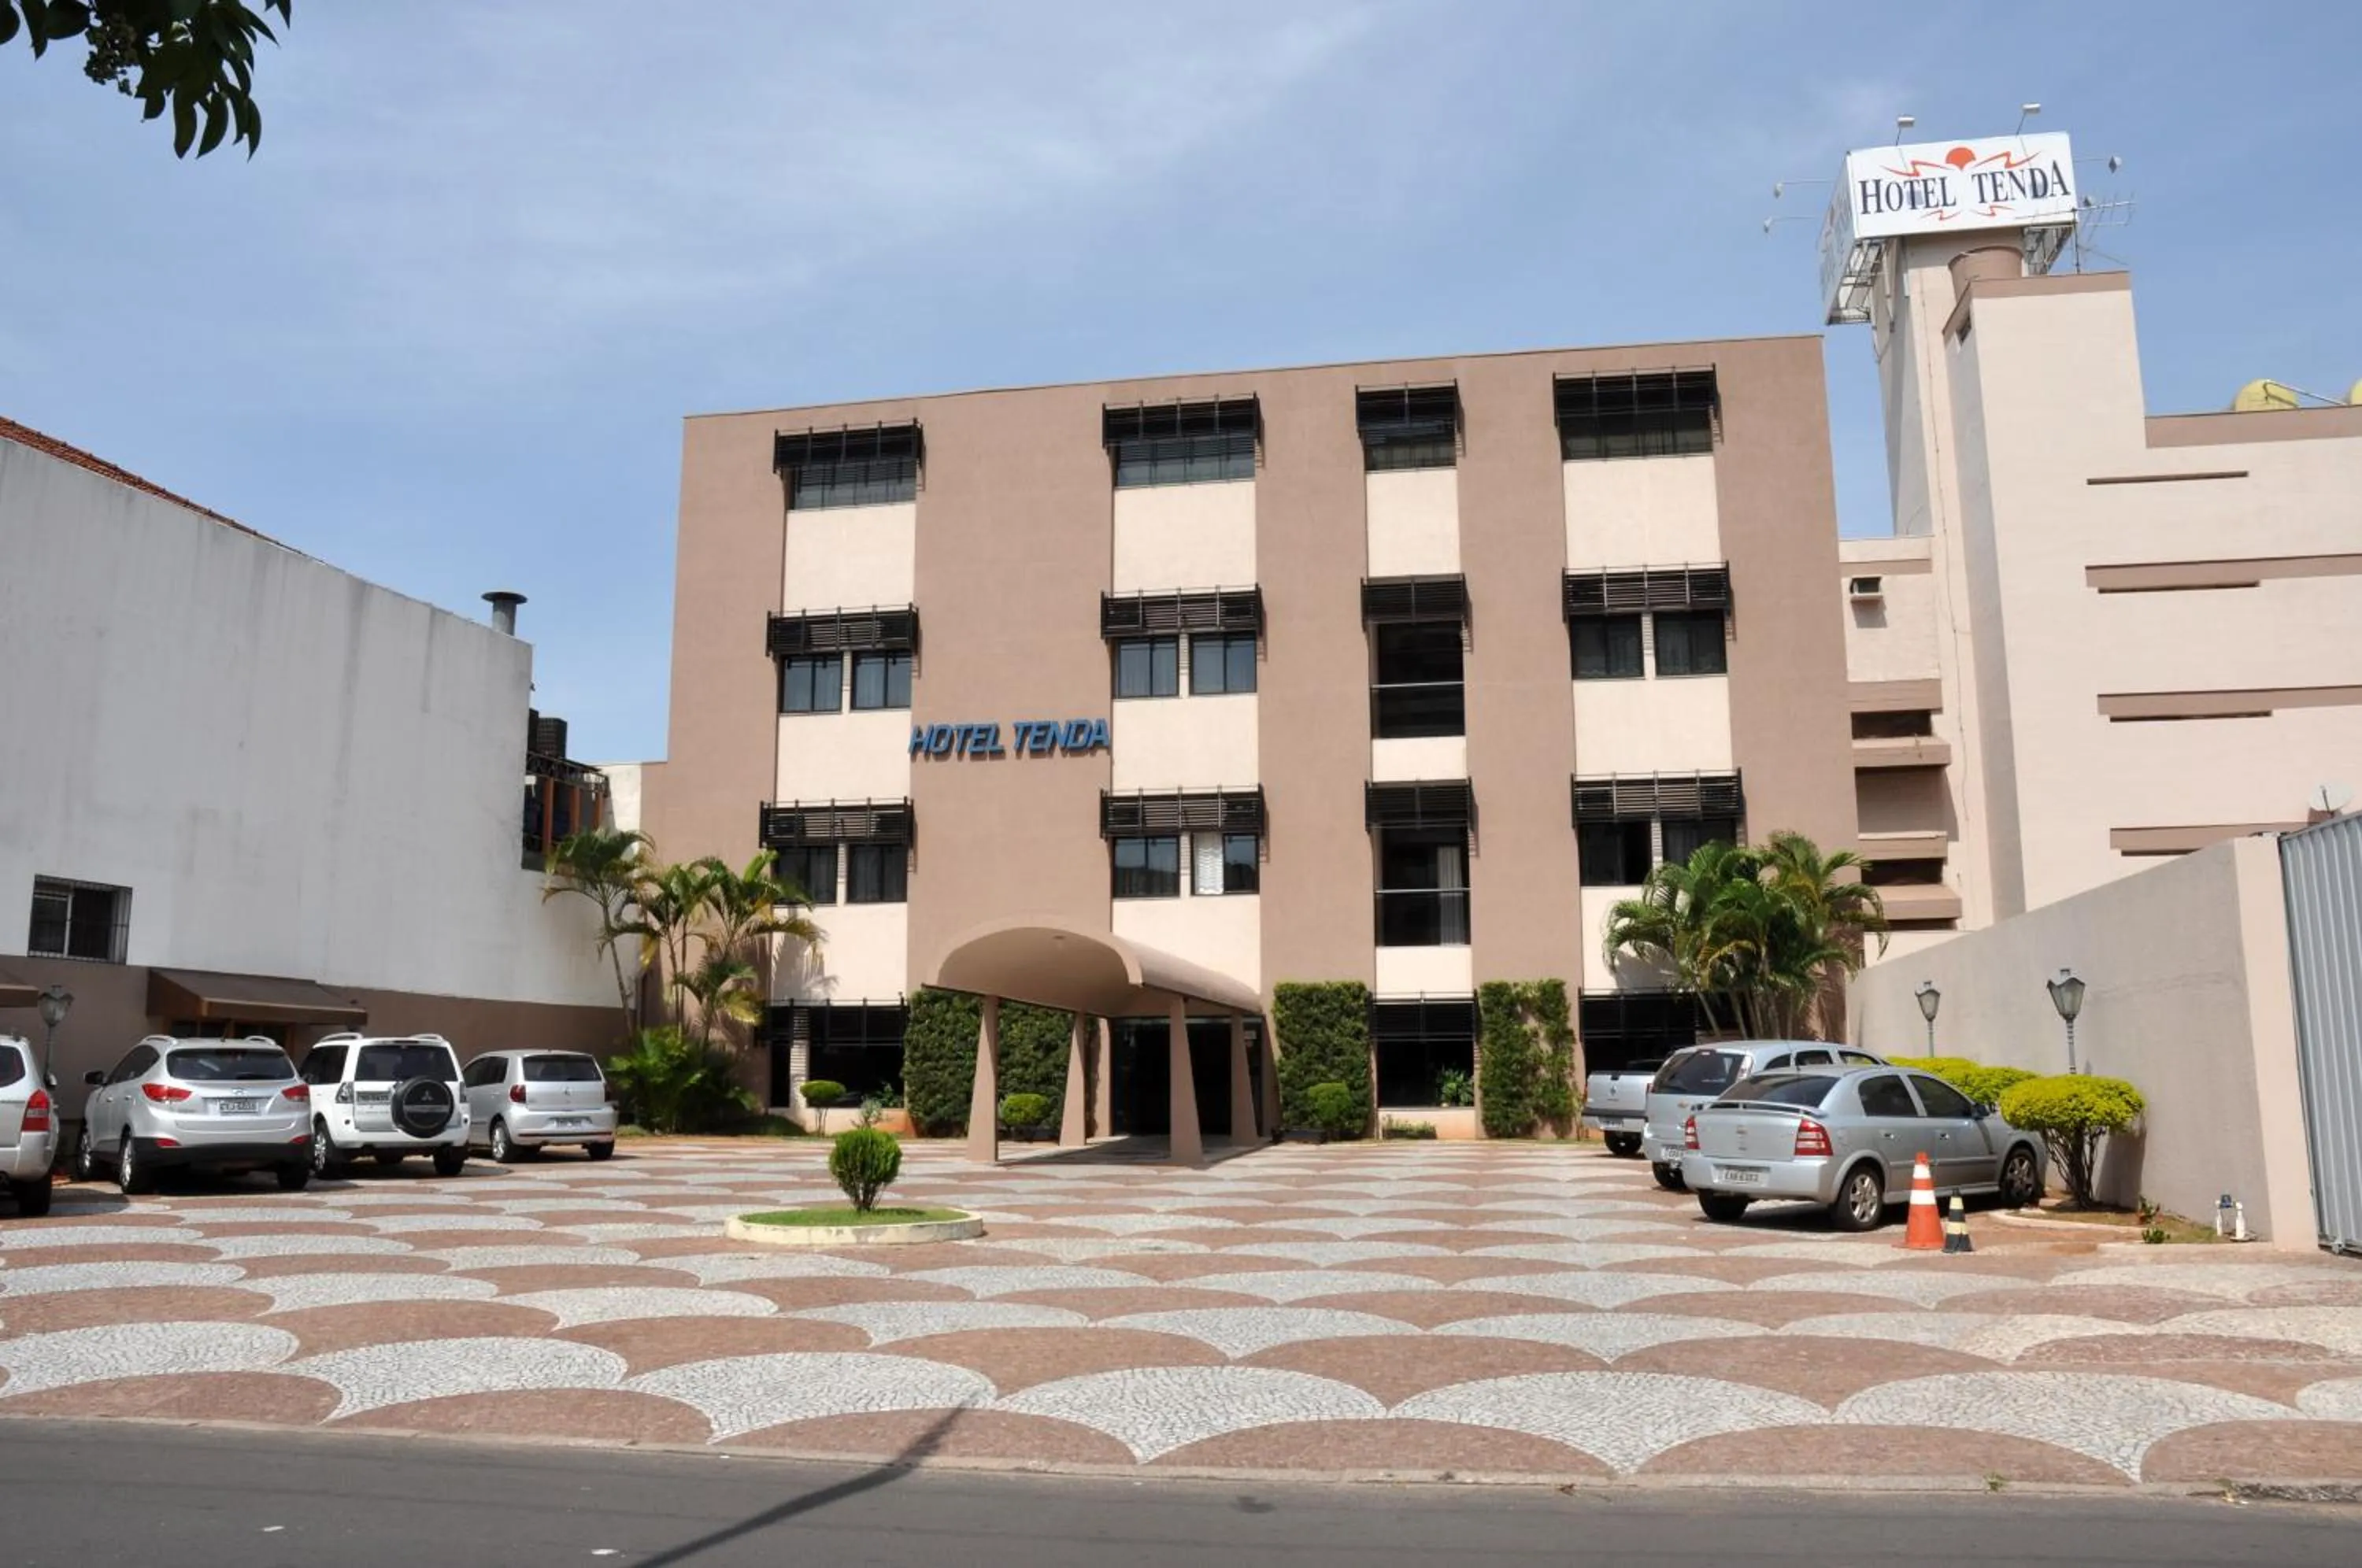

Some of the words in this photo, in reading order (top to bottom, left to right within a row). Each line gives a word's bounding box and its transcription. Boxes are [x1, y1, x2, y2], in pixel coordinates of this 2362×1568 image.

[1859, 176, 1957, 215] HOTEL
[1971, 159, 2071, 204] TENDA
[909, 722, 1005, 756] HOTEL
[1013, 718, 1111, 753] TENDA
